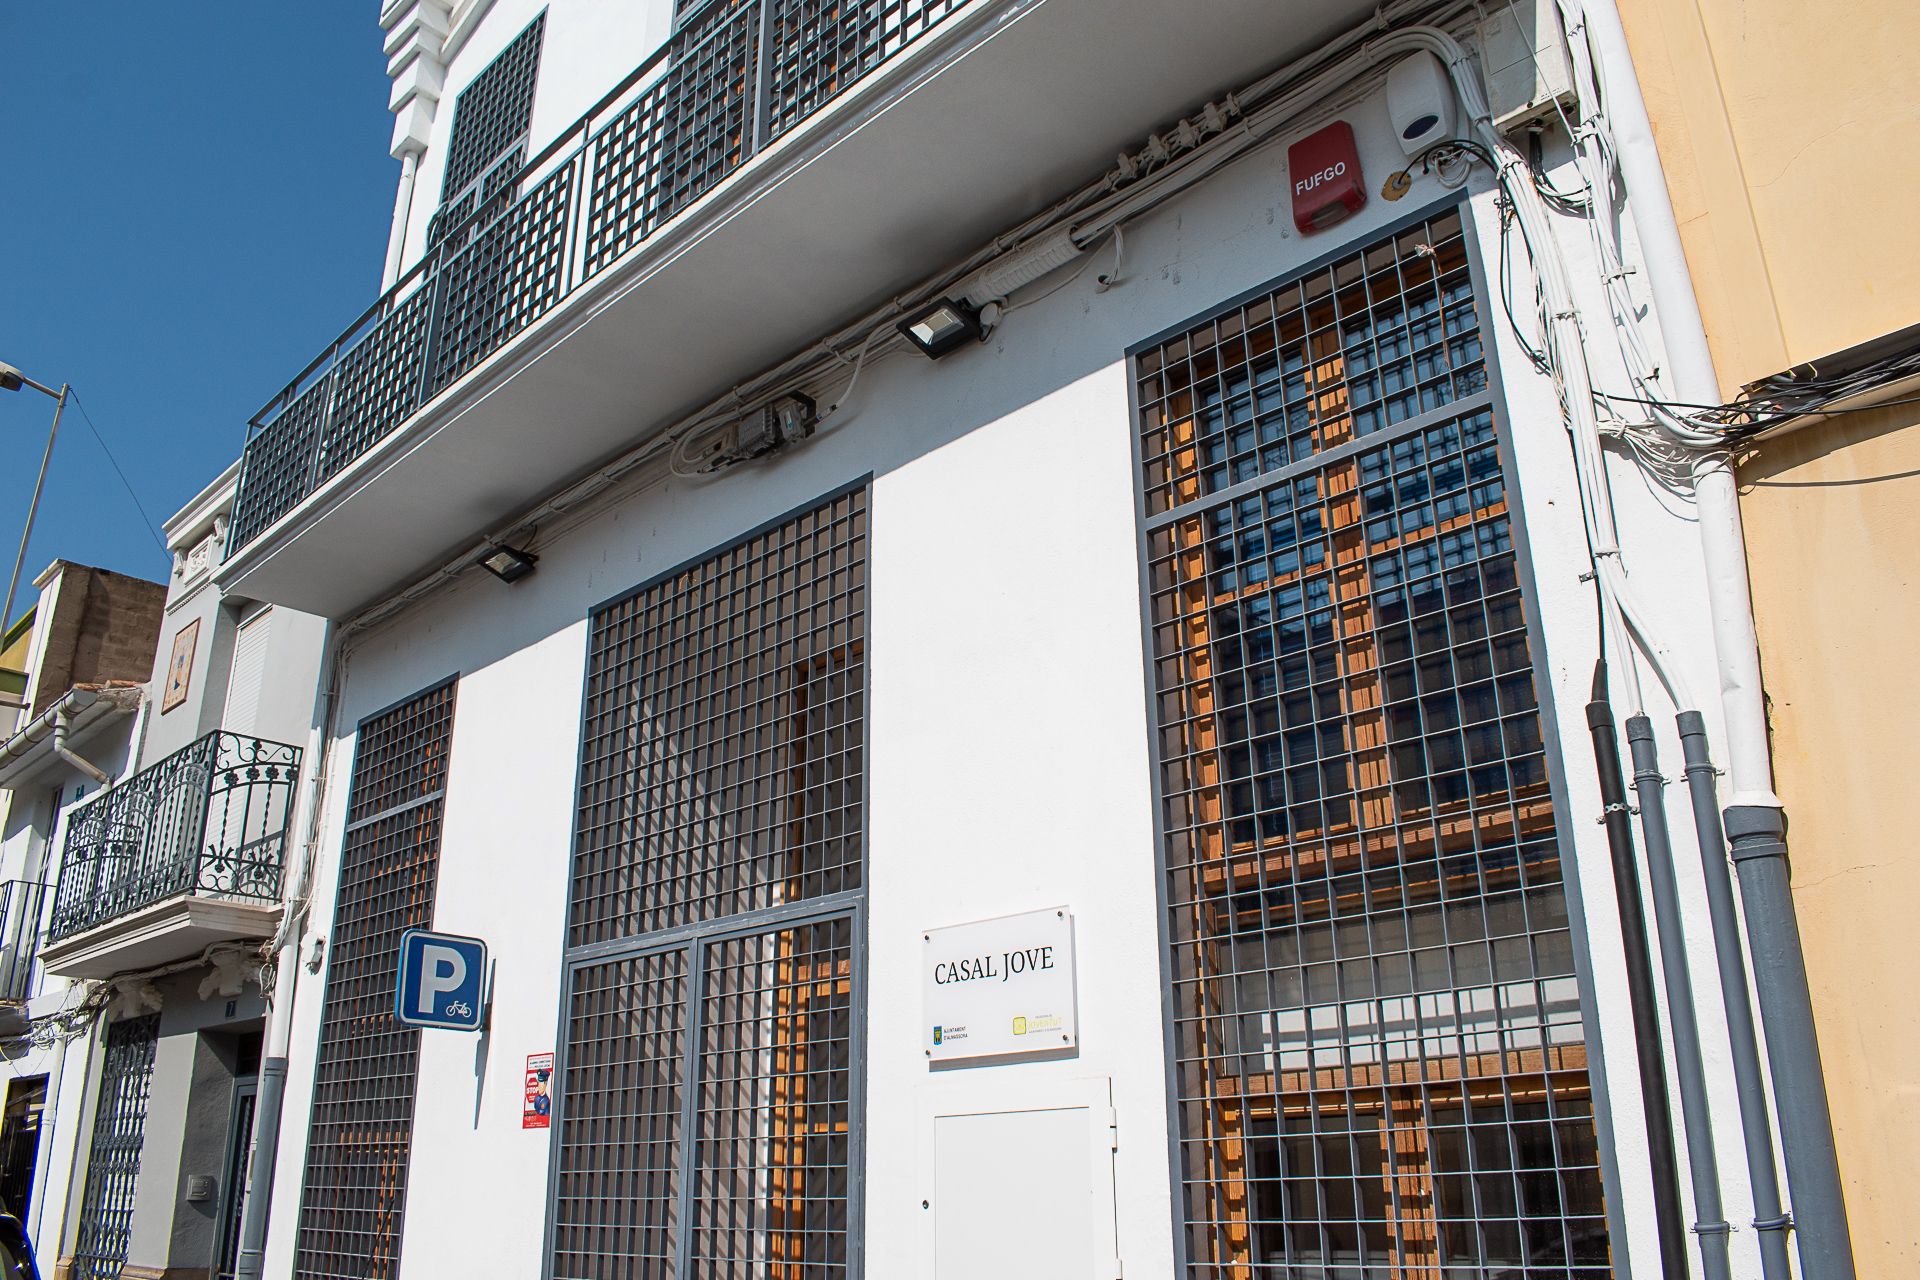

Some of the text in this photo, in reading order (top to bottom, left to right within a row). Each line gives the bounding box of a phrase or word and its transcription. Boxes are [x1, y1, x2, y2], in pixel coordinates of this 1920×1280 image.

[418, 944, 467, 1014] P
[935, 946, 1054, 985] CASAL JOVE
[1027, 1017, 1062, 1029] JOVENTUT
